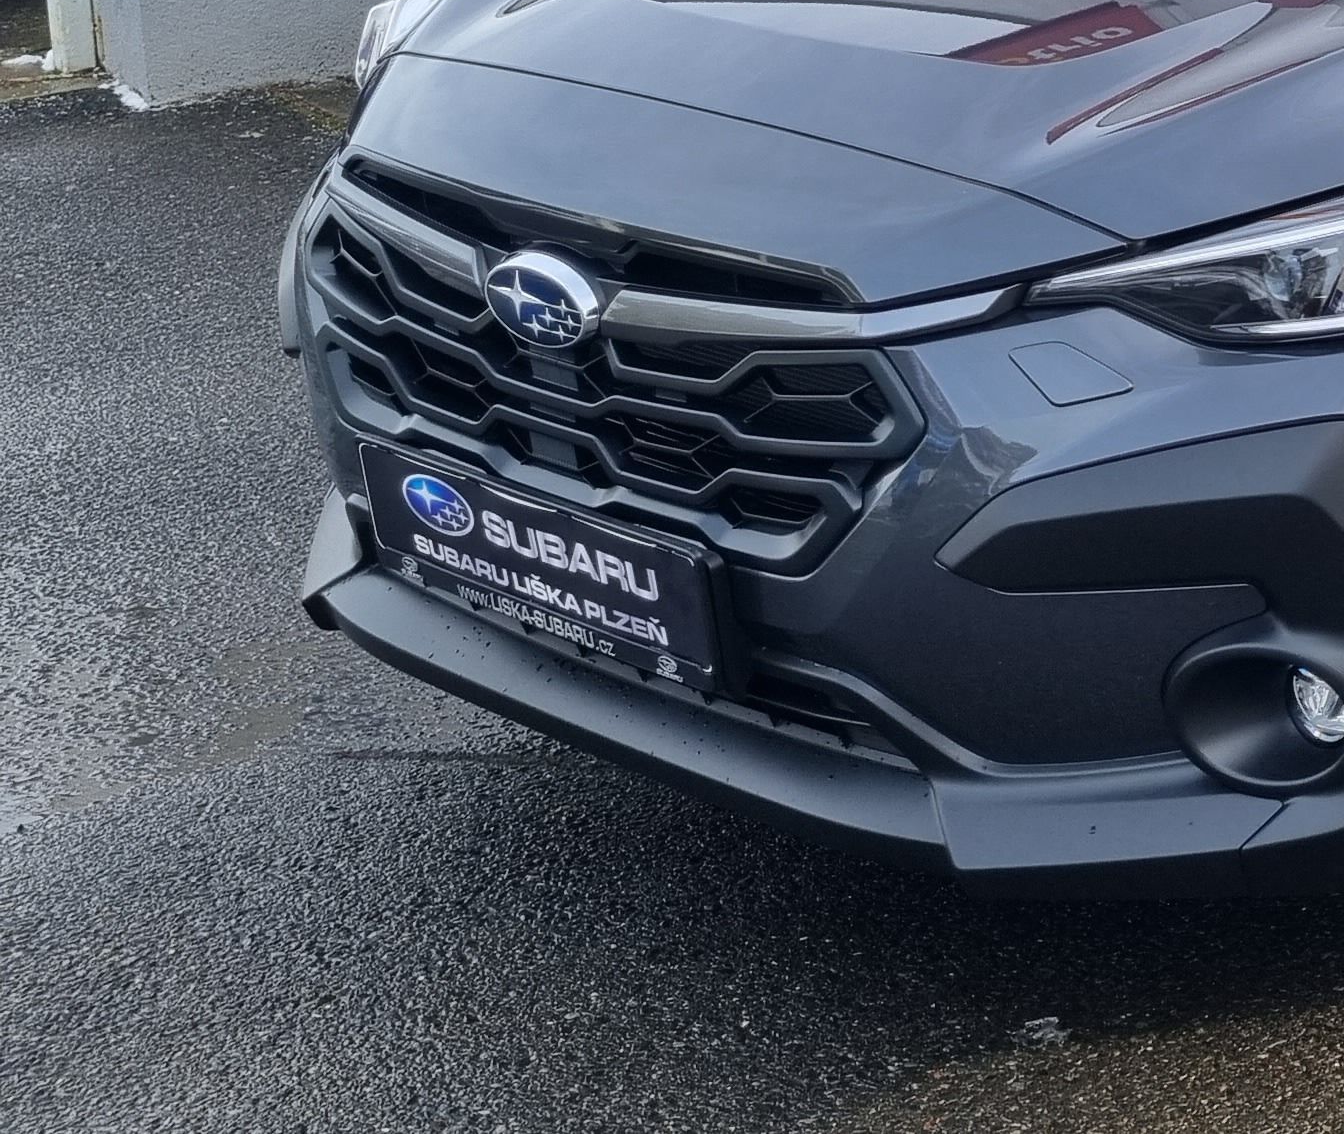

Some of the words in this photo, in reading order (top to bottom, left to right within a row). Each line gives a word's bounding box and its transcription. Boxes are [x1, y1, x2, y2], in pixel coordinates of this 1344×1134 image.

[413, 533, 509, 587] SUBARU
[512, 573, 583, 616] LIŠKA
[584, 598, 669, 646] PLZEŇ
[482, 509, 659, 602] SUBARU
[457, 584, 616, 658] www.LISKA-SUBARU.cz
